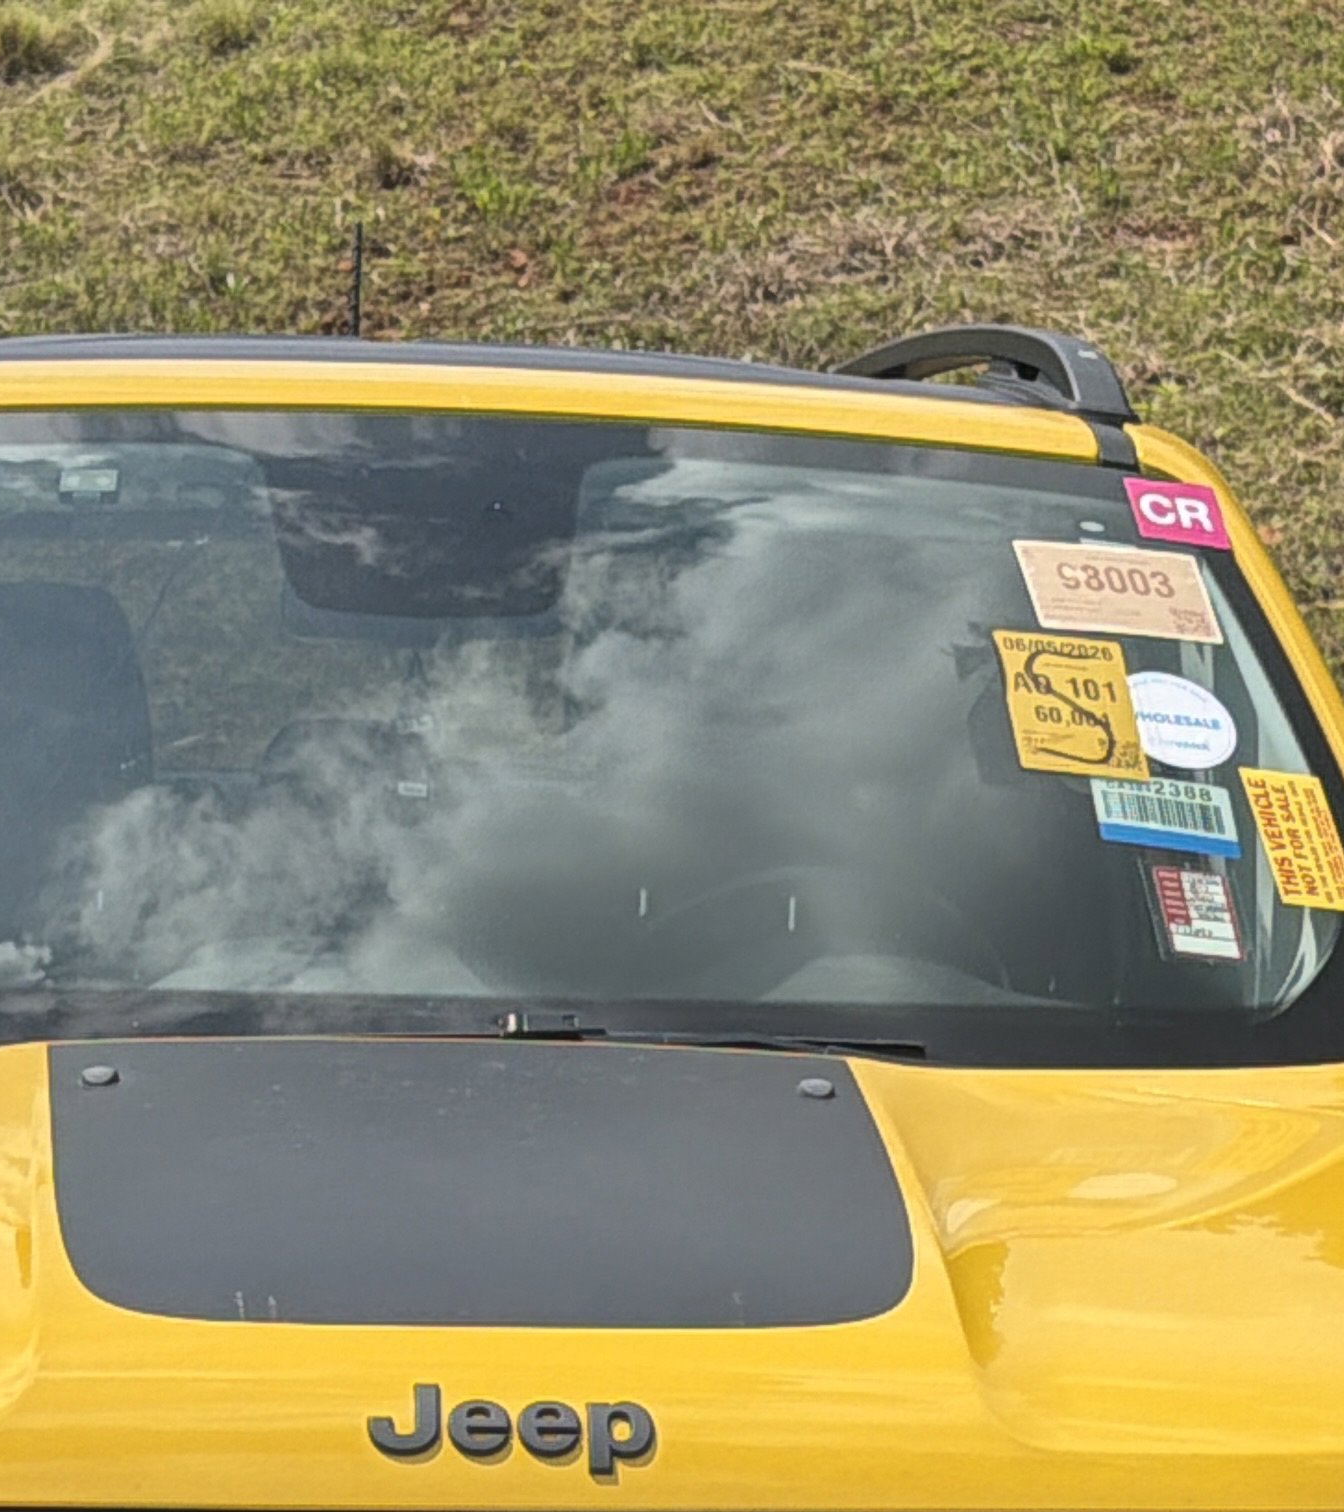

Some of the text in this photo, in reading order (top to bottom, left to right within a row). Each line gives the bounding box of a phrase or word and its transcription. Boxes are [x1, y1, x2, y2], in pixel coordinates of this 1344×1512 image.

[1139, 493, 1215, 533] CR
[1065, 677, 1117, 703] 101
[1270, 783, 1296, 825] SALE
[1247, 777, 1303, 896] THIS VEHICLE
[1286, 828, 1309, 861] FOR
[1297, 863, 1320, 897] NOT
[367, 1382, 656, 1475] Jeep
